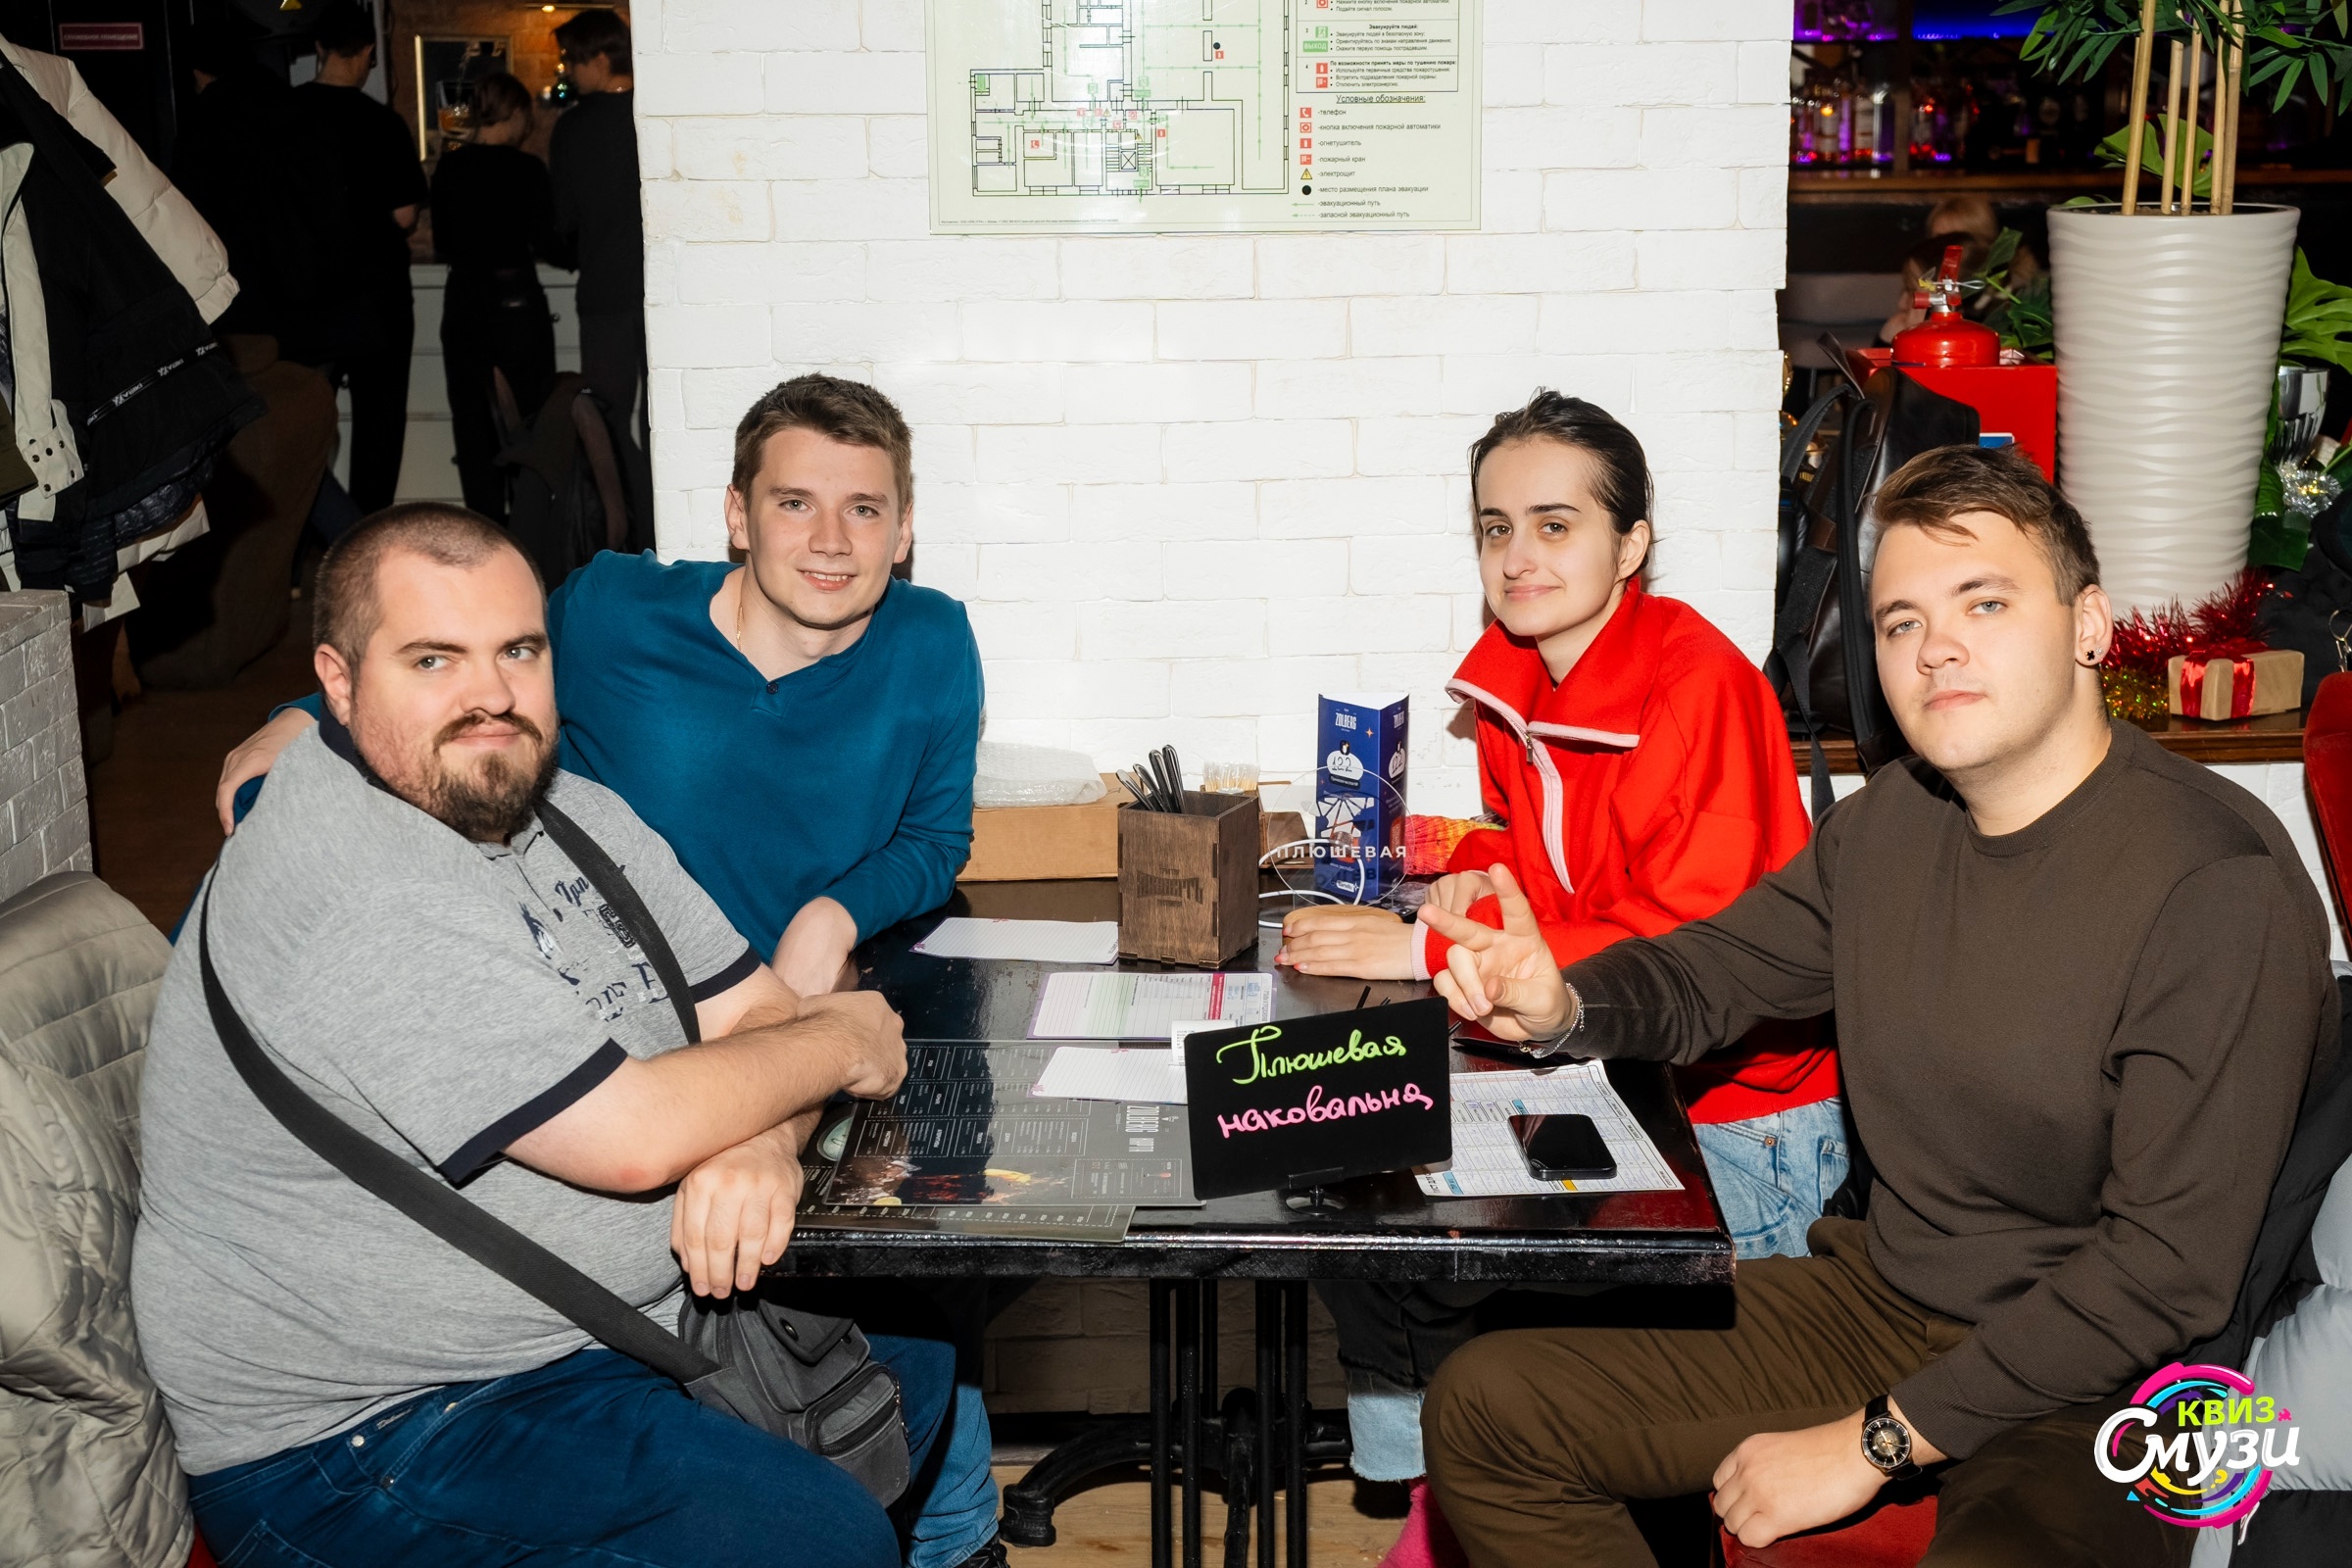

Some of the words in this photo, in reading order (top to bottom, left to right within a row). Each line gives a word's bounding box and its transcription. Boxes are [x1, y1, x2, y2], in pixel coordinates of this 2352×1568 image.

[1336, 95, 1374, 104] Условные
[1376, 94, 1426, 103] обозначения:
[1335, 711, 1357, 731] ZOLBERG
[1277, 845, 1407, 858] ПЛЮШЕВАЯ
[1216, 1025, 1407, 1085] Плюшевая
[1125, 1105, 1160, 1133] ZOLBERG
[1216, 1082, 1435, 1139] наковальня
